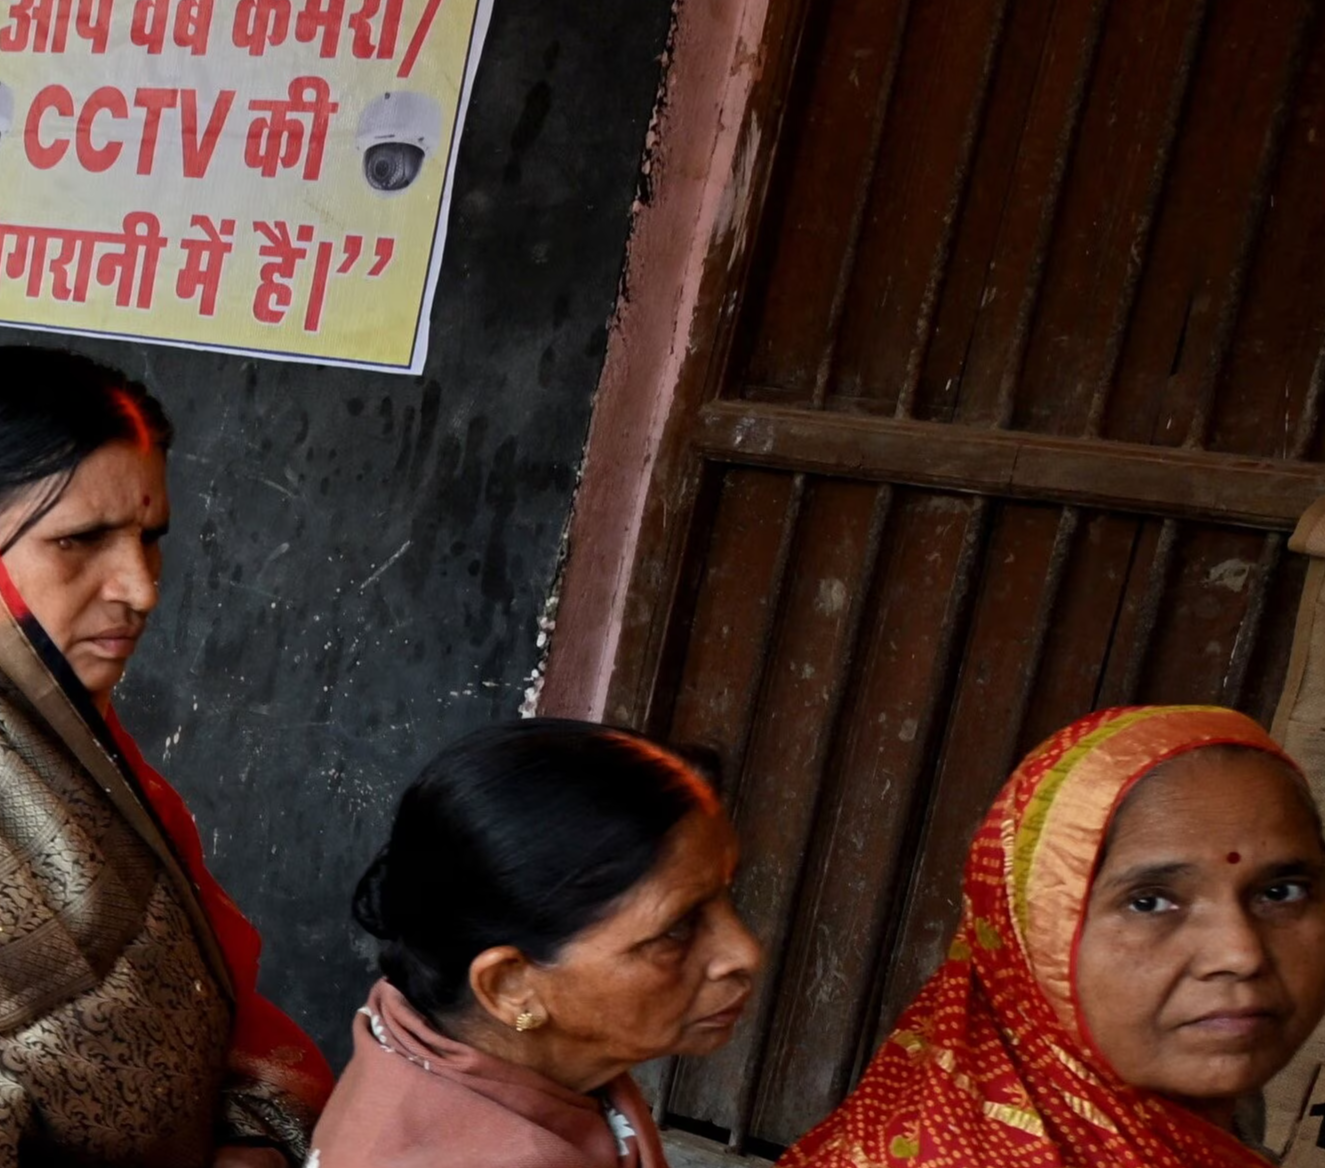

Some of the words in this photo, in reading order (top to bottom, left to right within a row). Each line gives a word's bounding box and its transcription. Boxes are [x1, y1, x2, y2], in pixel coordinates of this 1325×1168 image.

[23, 84, 235, 178] CCTV
[243, 76, 338, 181] की
[175, 213, 236, 316] में
